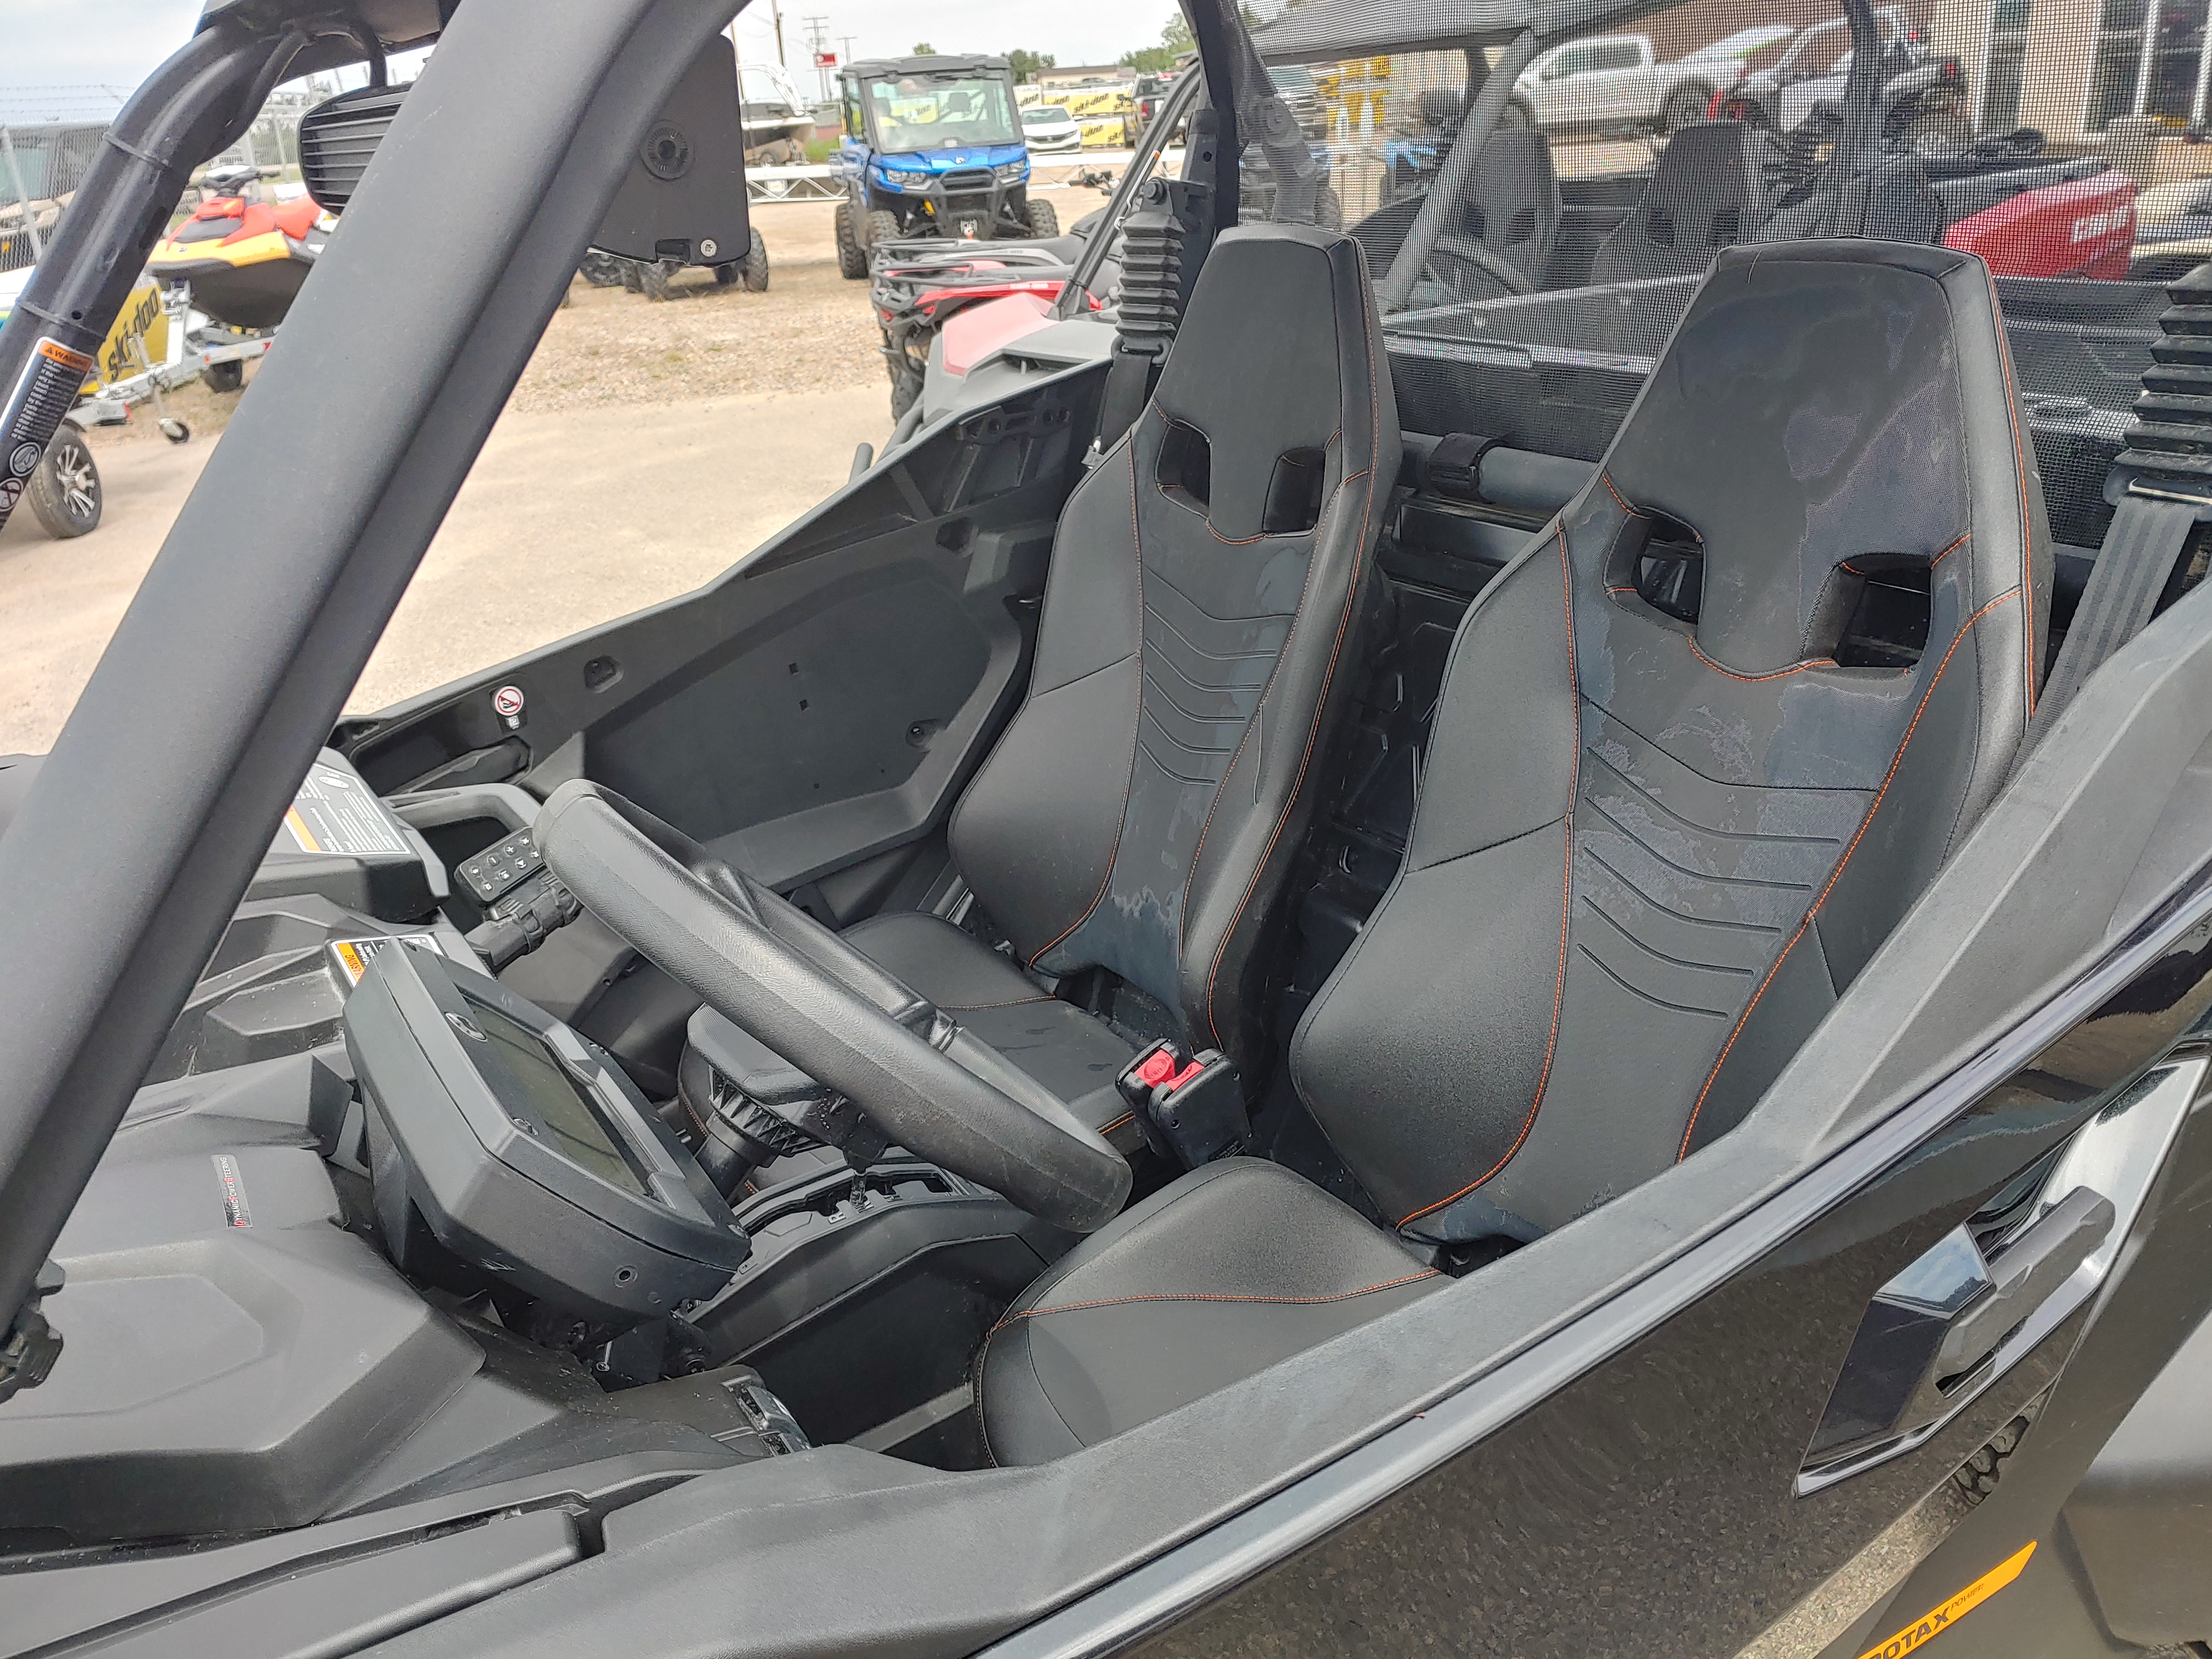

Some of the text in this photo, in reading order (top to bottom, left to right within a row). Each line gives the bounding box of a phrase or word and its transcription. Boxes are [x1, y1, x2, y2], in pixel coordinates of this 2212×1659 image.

[109, 287, 159, 381] skidoo
[219, 1156, 245, 1226] DYNAMIC POWER STEERING
[828, 1211, 847, 1224] R
[1866, 1583, 1984, 1659] OTAX POWER
